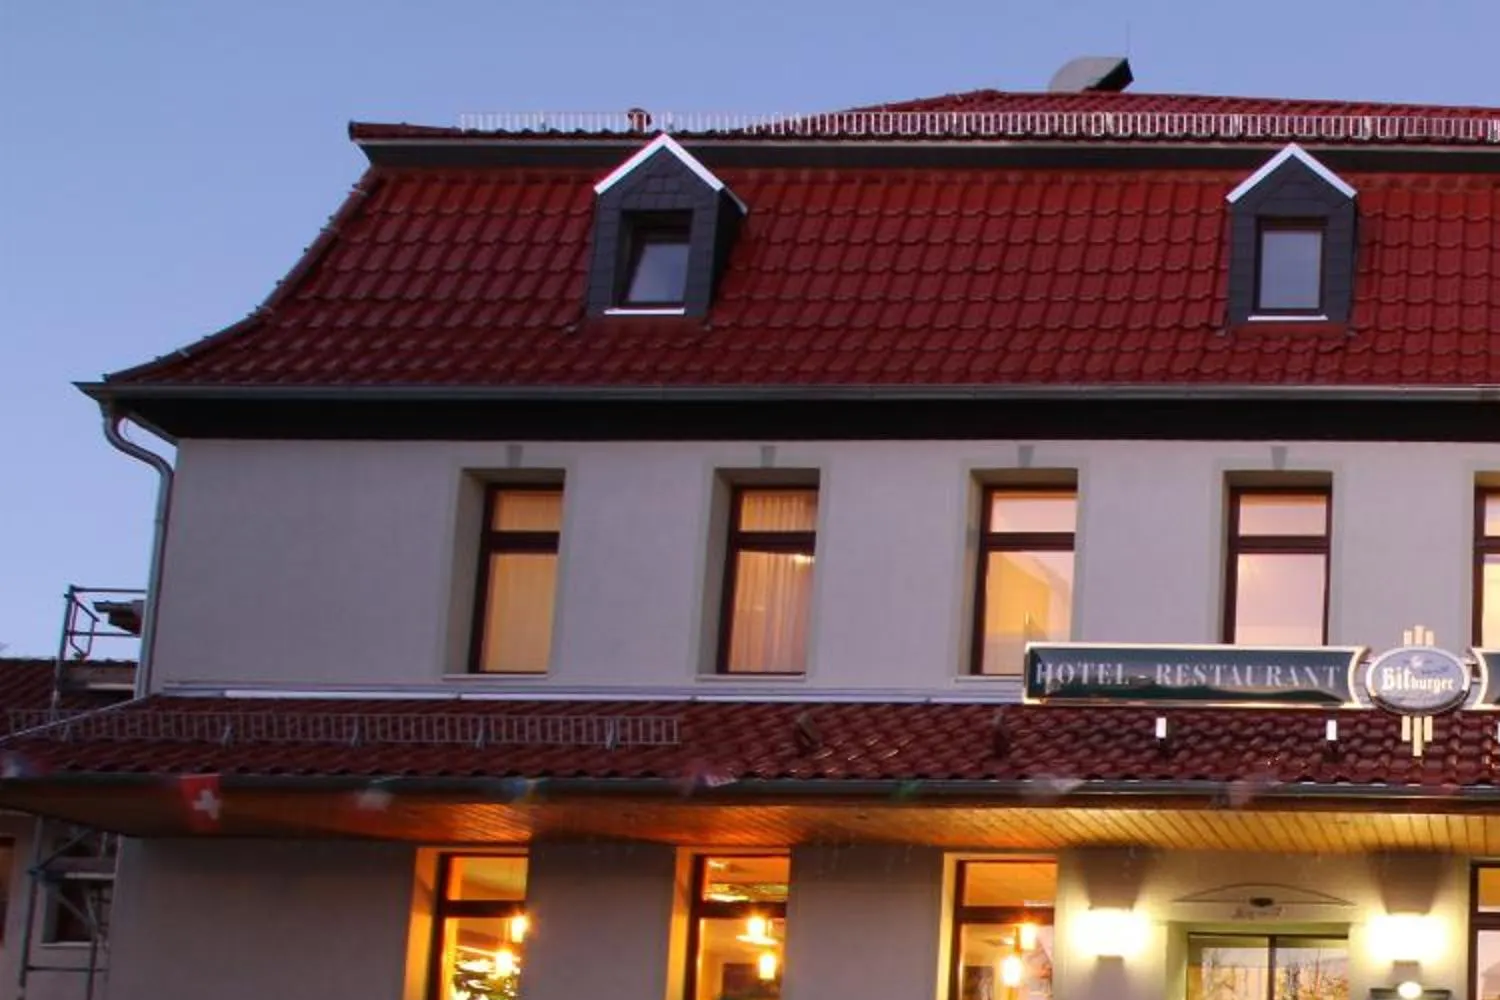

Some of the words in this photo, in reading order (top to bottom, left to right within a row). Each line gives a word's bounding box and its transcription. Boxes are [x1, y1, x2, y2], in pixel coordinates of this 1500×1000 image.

[1035, 661, 1130, 687] HOTEL
[1156, 662, 1342, 689] RESTAURANT
[1382, 665, 1455, 694] Bitburger
